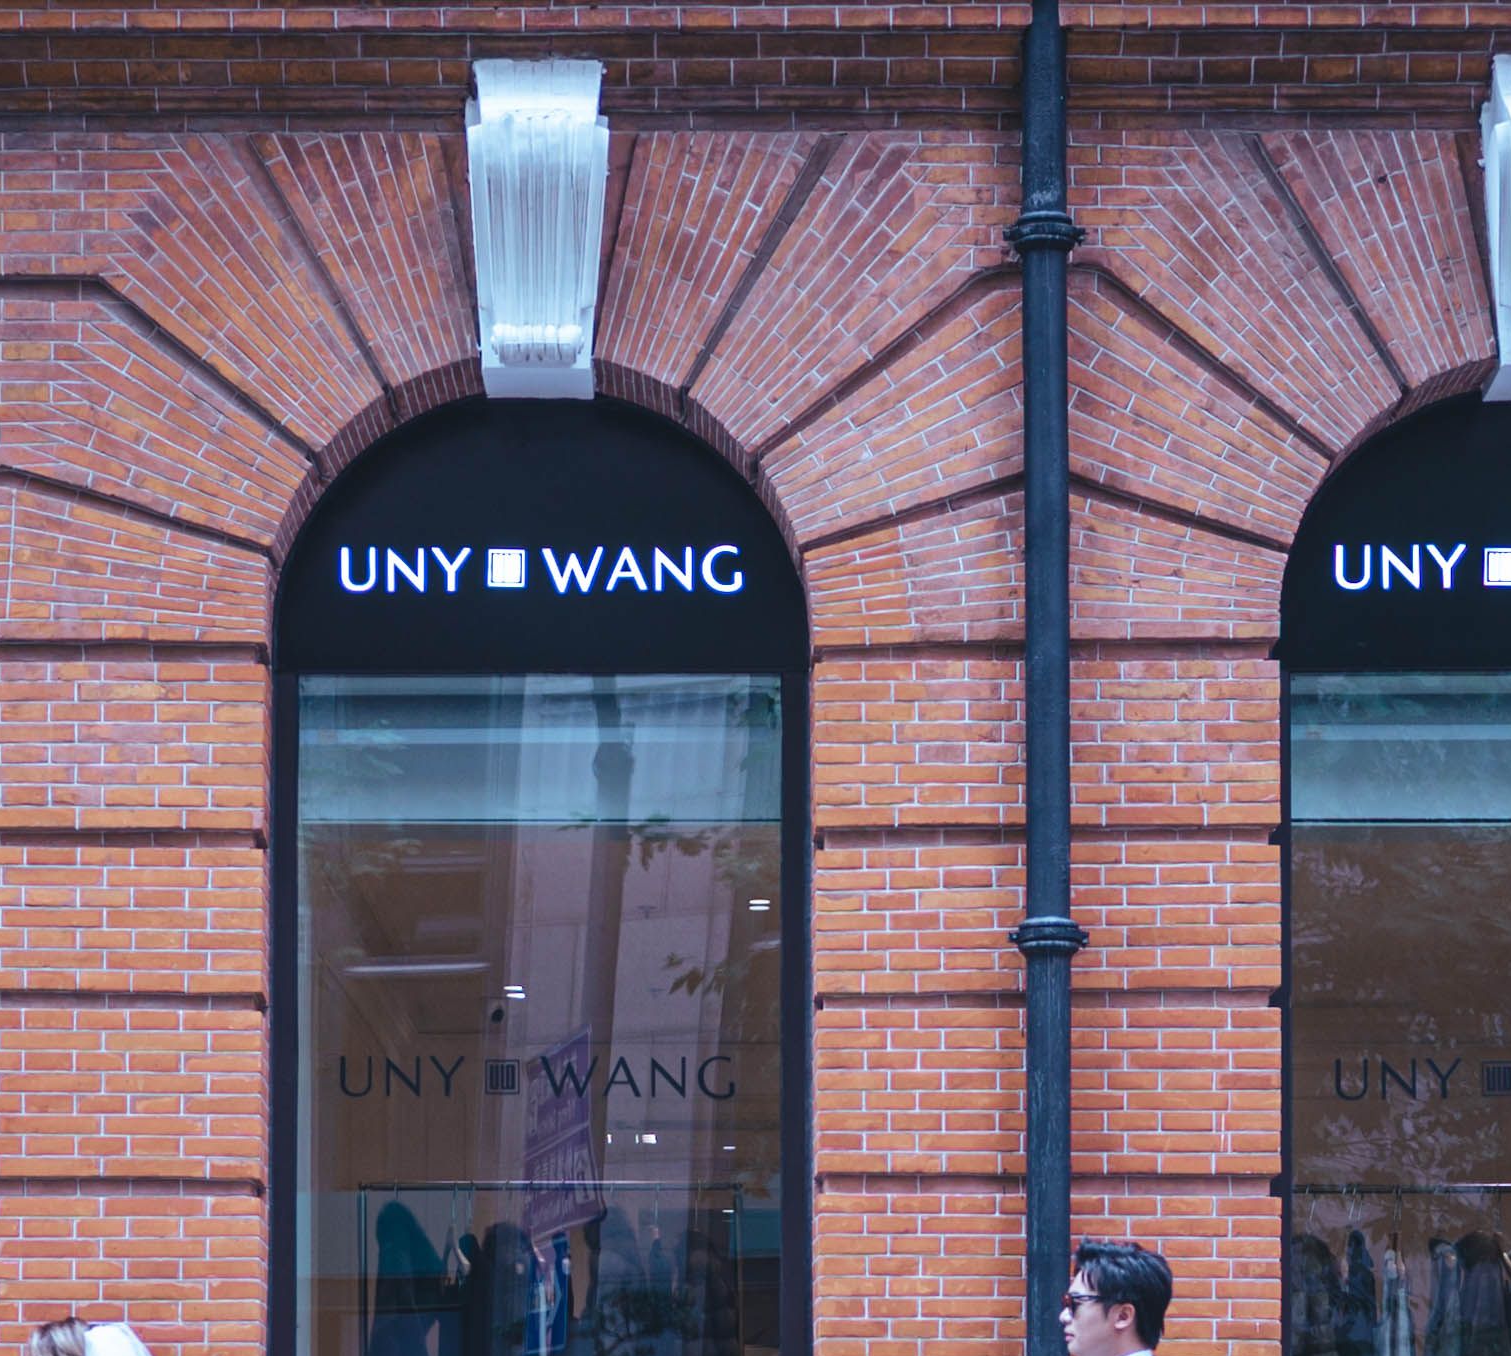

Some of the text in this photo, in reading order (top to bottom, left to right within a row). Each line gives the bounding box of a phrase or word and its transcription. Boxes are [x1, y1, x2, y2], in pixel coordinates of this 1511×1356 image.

[339, 546, 744, 594] UNY WANG
[1334, 544, 1466, 591] UNY
[339, 1055, 736, 1100] UNY WANG
[1334, 1057, 1462, 1101] UNY
